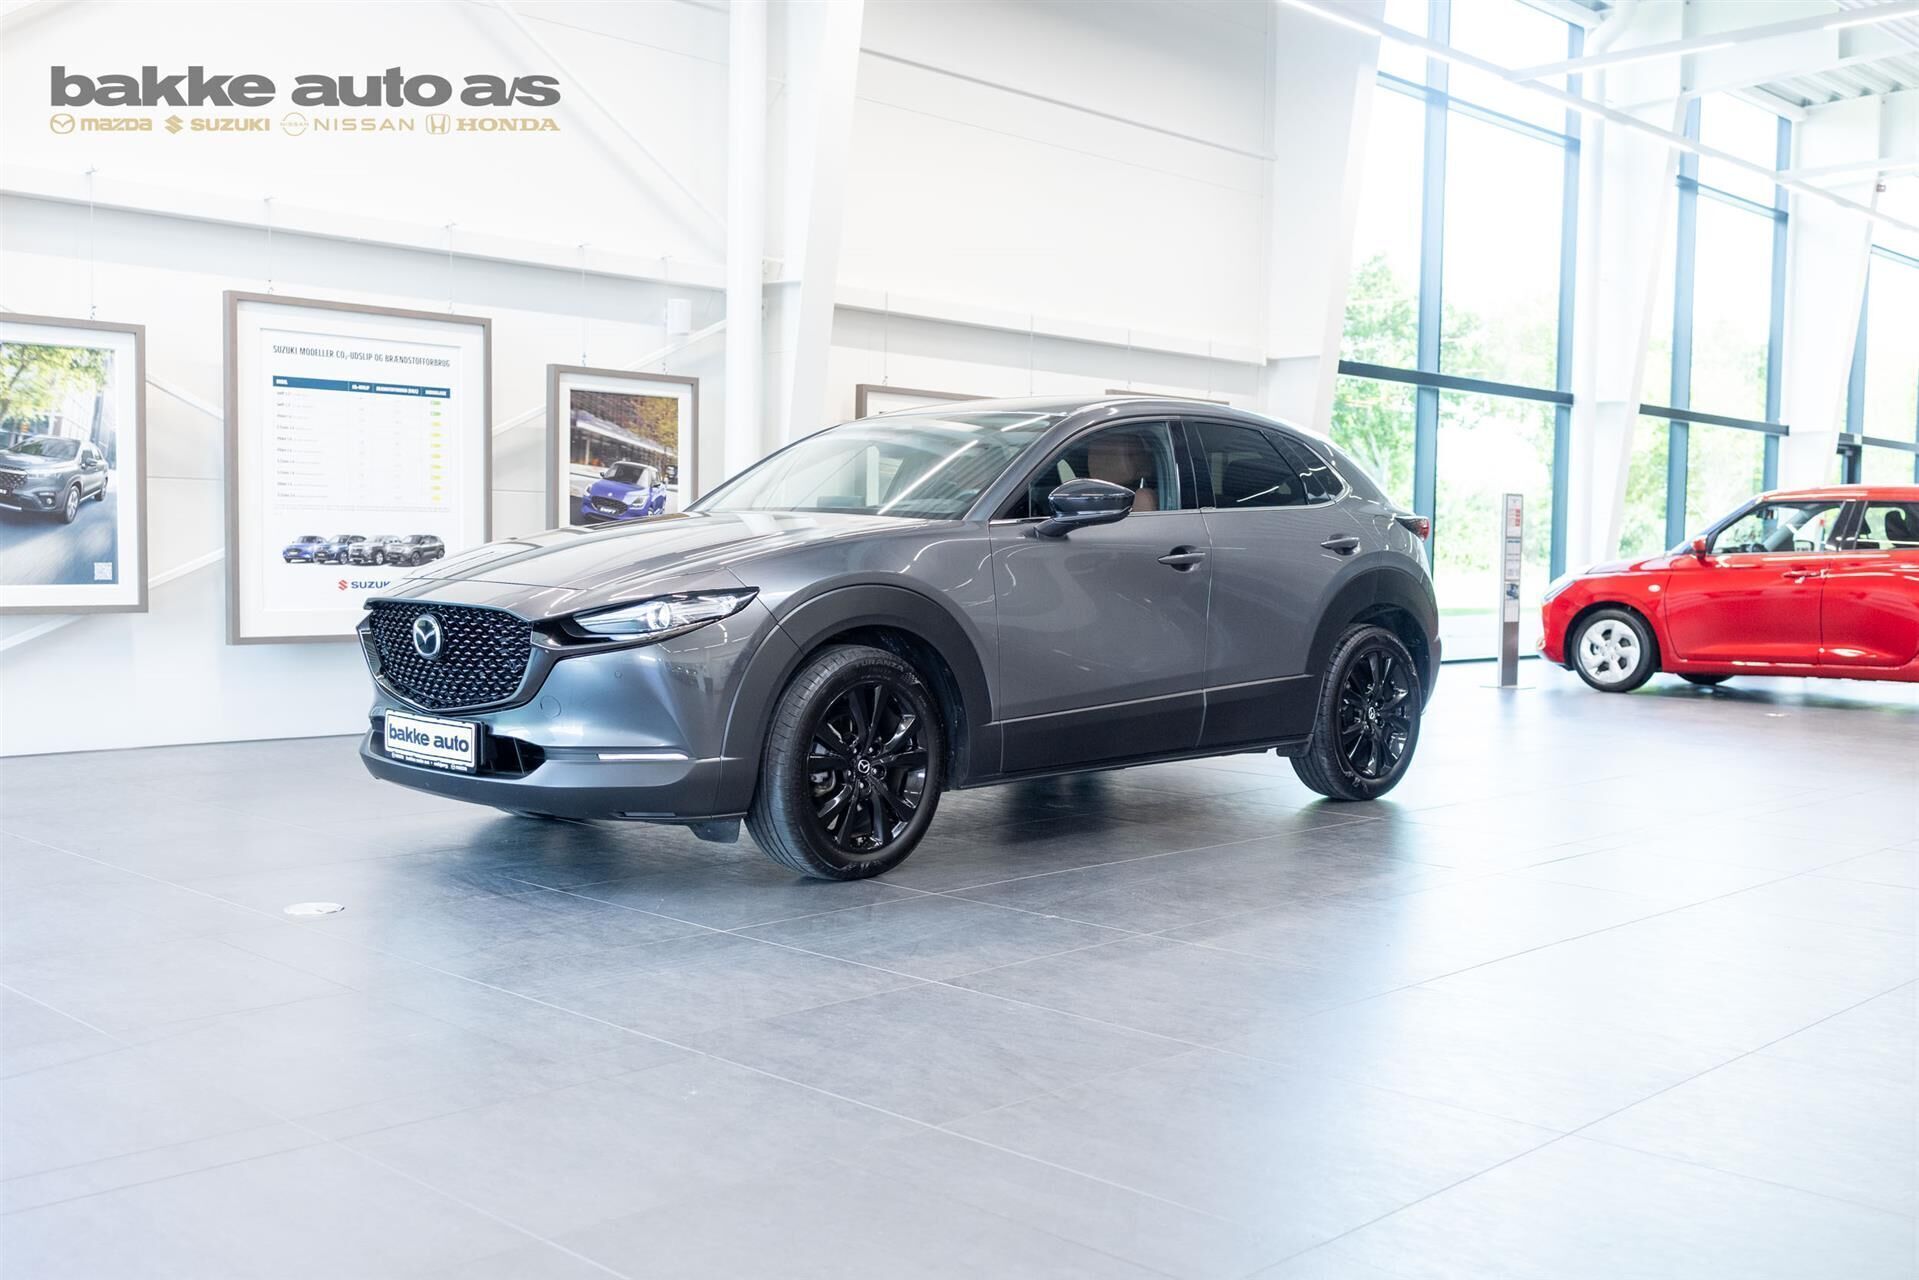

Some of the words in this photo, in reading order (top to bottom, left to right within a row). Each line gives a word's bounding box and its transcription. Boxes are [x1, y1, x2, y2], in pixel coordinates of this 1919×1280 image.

[272, 345, 298, 355] SUZUKI
[299, 347, 334, 358] MODELLER
[374, 354, 383, 362] OG
[389, 723, 430, 746] bakke
[433, 735, 469, 752] auto
